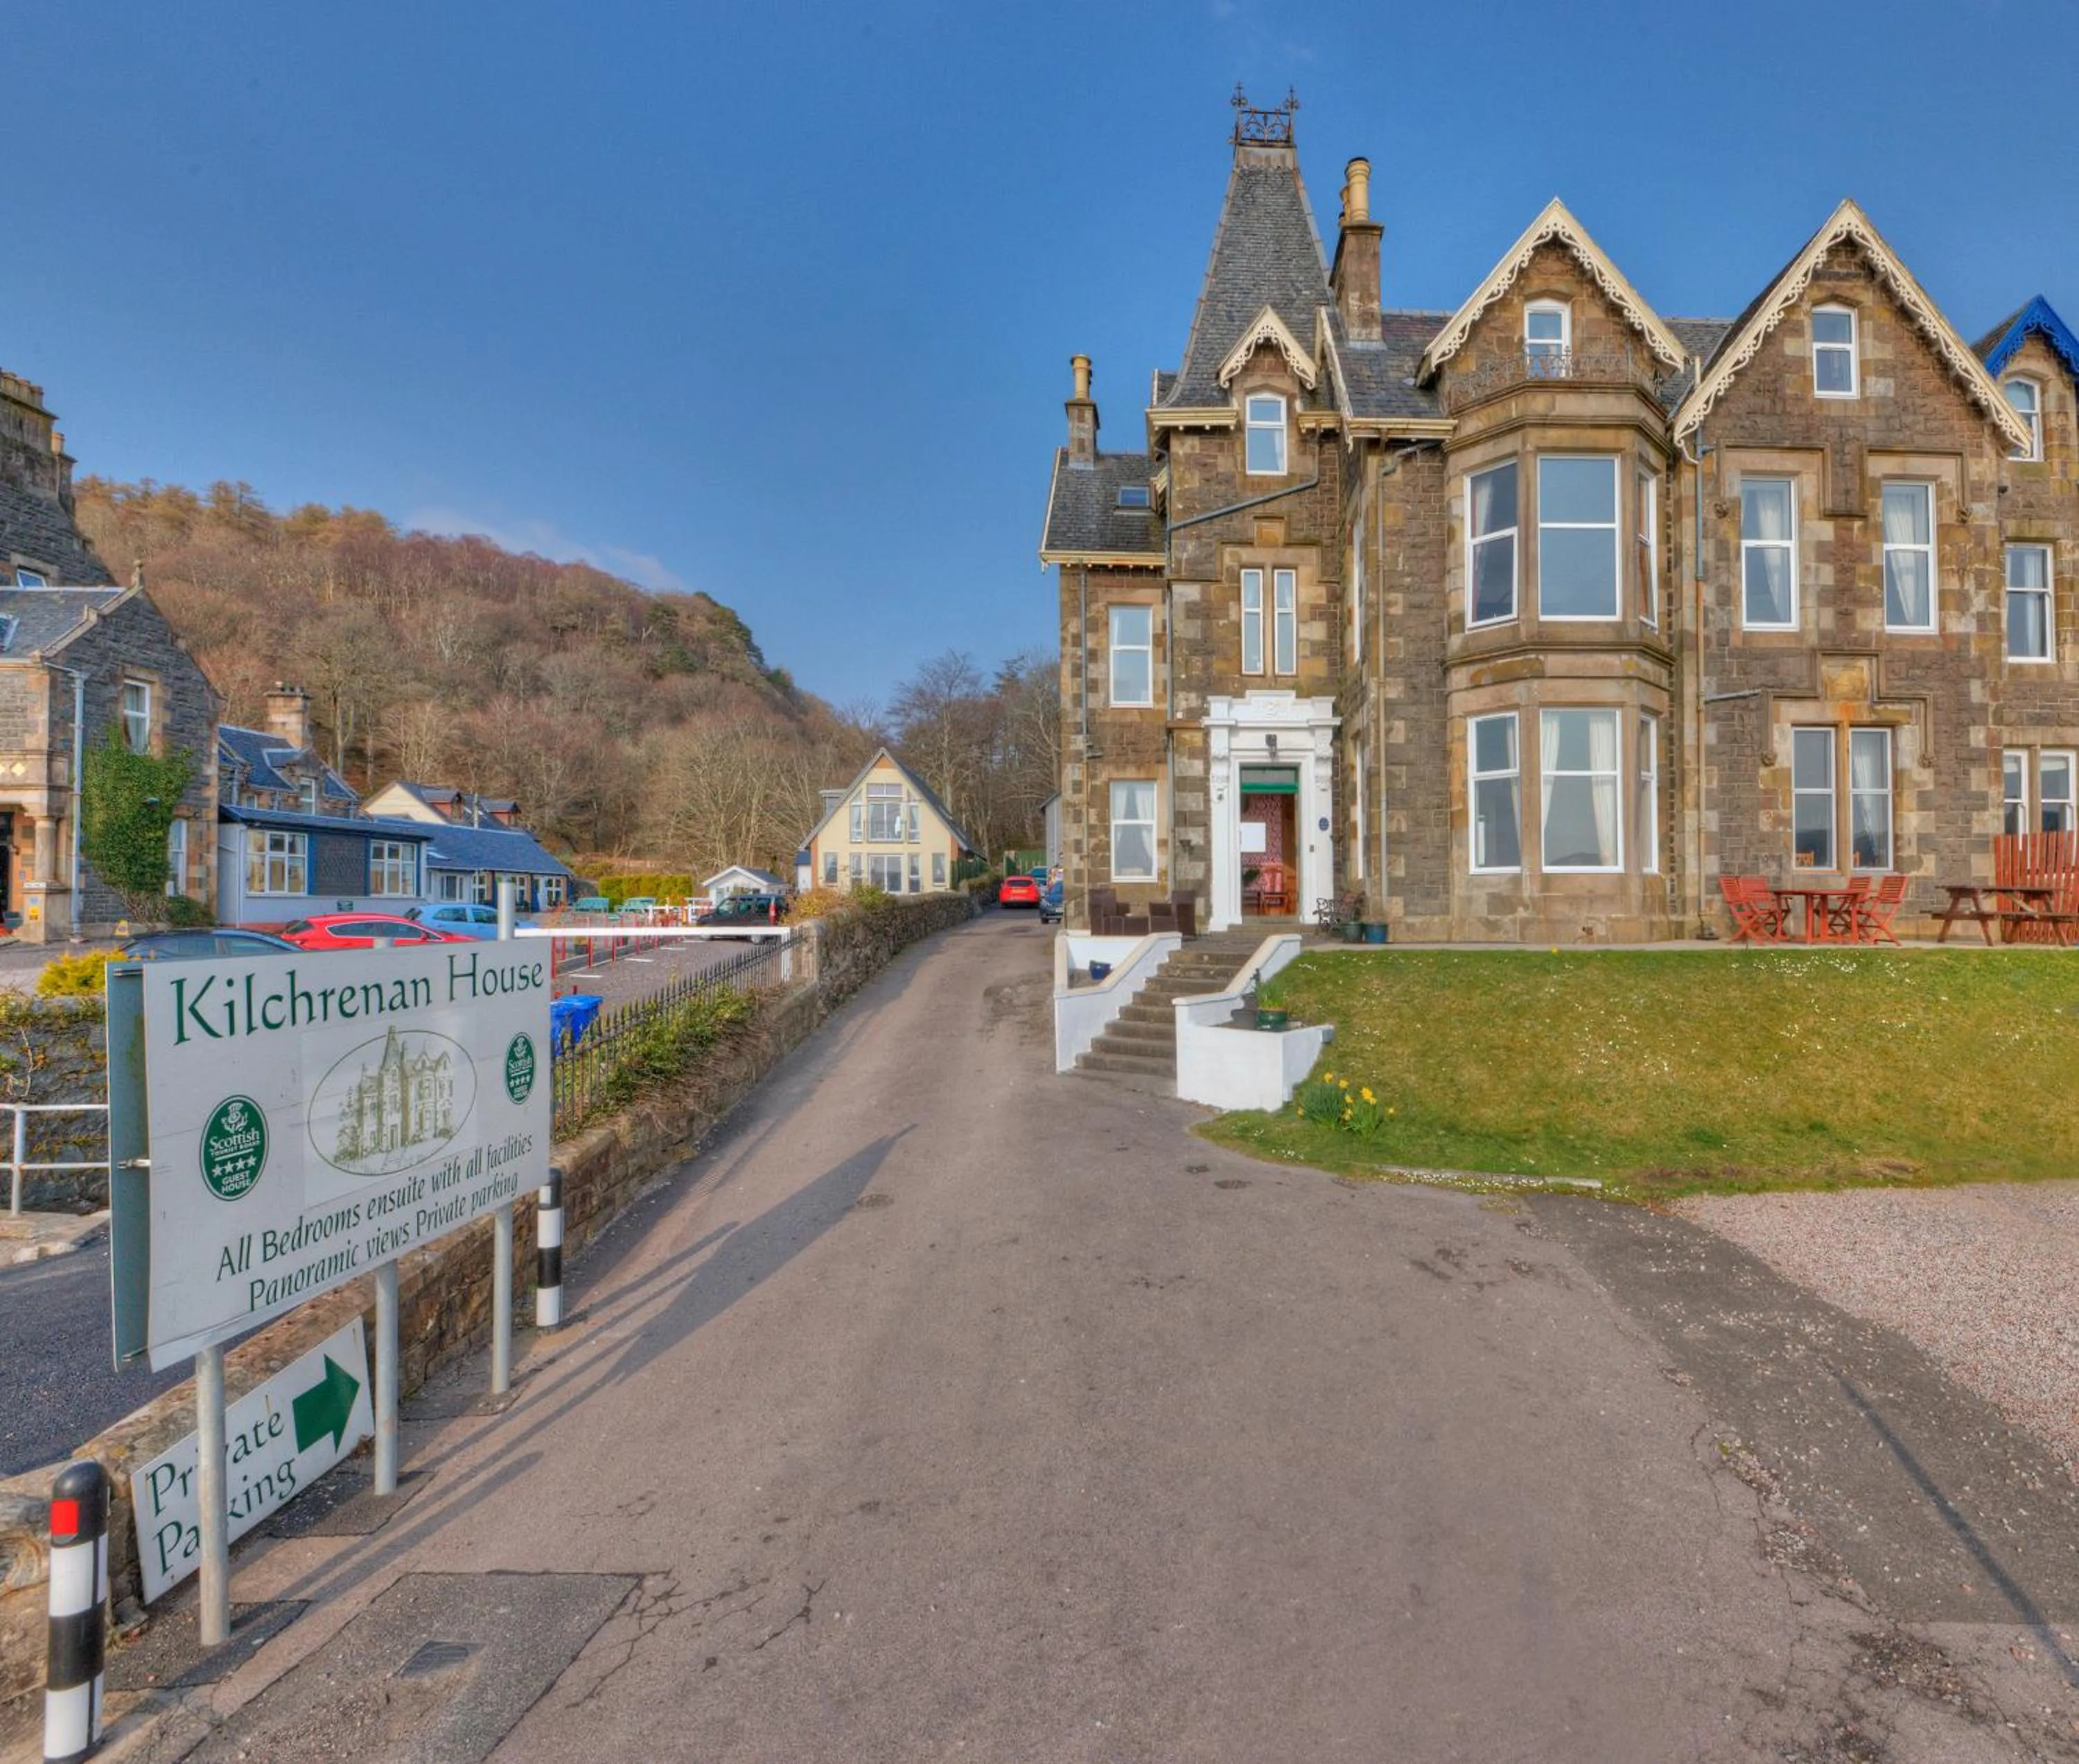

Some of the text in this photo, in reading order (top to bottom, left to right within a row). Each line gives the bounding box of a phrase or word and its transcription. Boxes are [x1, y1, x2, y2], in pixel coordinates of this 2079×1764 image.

[170, 952, 544, 1046] Kilchrenan House
[209, 1127, 261, 1149] Scottish
[221, 1179, 252, 1194] HOUSE
[222, 1170, 251, 1185] GUEST
[216, 1132, 532, 1282] All Bedrooms ensuite with all facilities
[250, 1172, 518, 1312] Panoramic views Private parking
[146, 1411, 285, 1517] Prate
[153, 1458, 295, 1576] Paing
